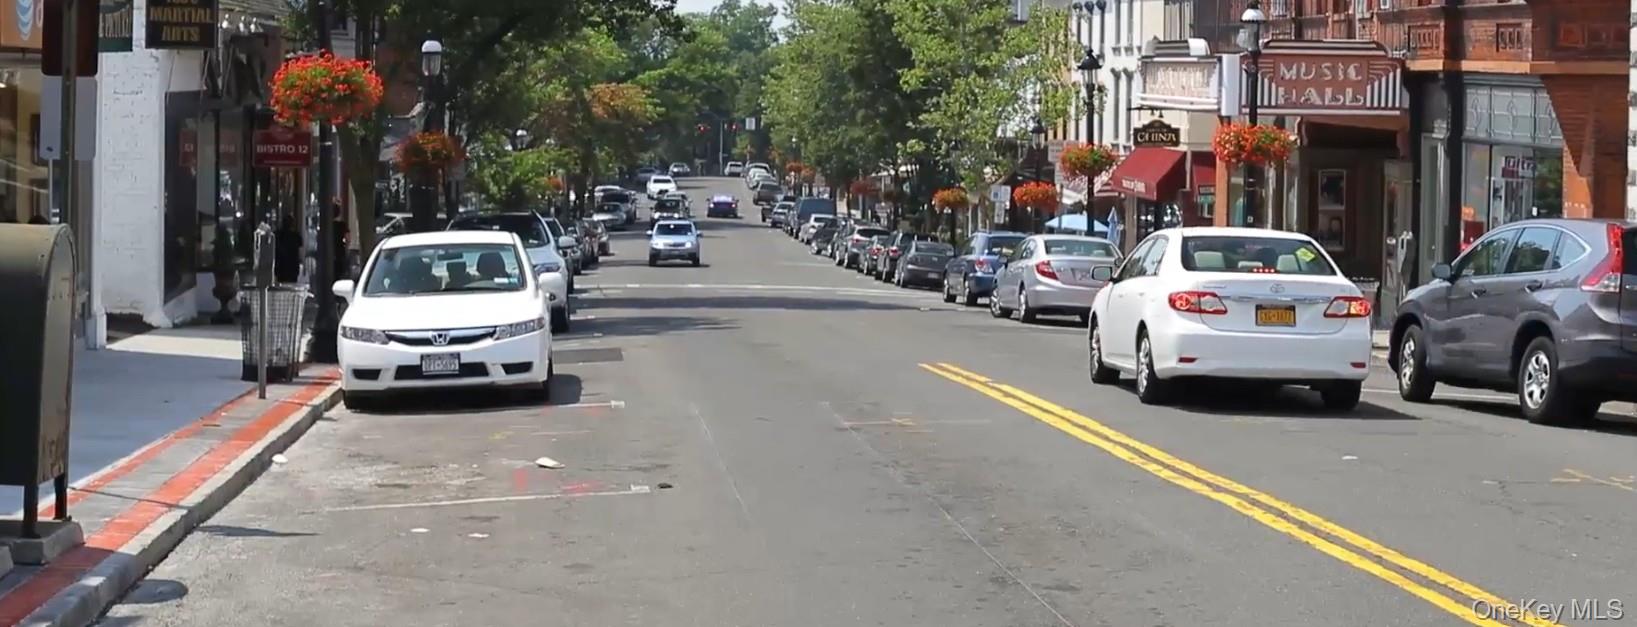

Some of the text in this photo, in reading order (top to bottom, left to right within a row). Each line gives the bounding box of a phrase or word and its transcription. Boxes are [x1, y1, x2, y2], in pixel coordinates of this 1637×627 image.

[150, 7, 213, 23] MARTIAL
[161, 26, 200, 42] ARTS
[1280, 62, 1362, 80] MUSIC
[1278, 87, 1364, 105] HALL
[1137, 132, 1176, 142] CHINA
[256, 144, 308, 153] BISTRO 12
